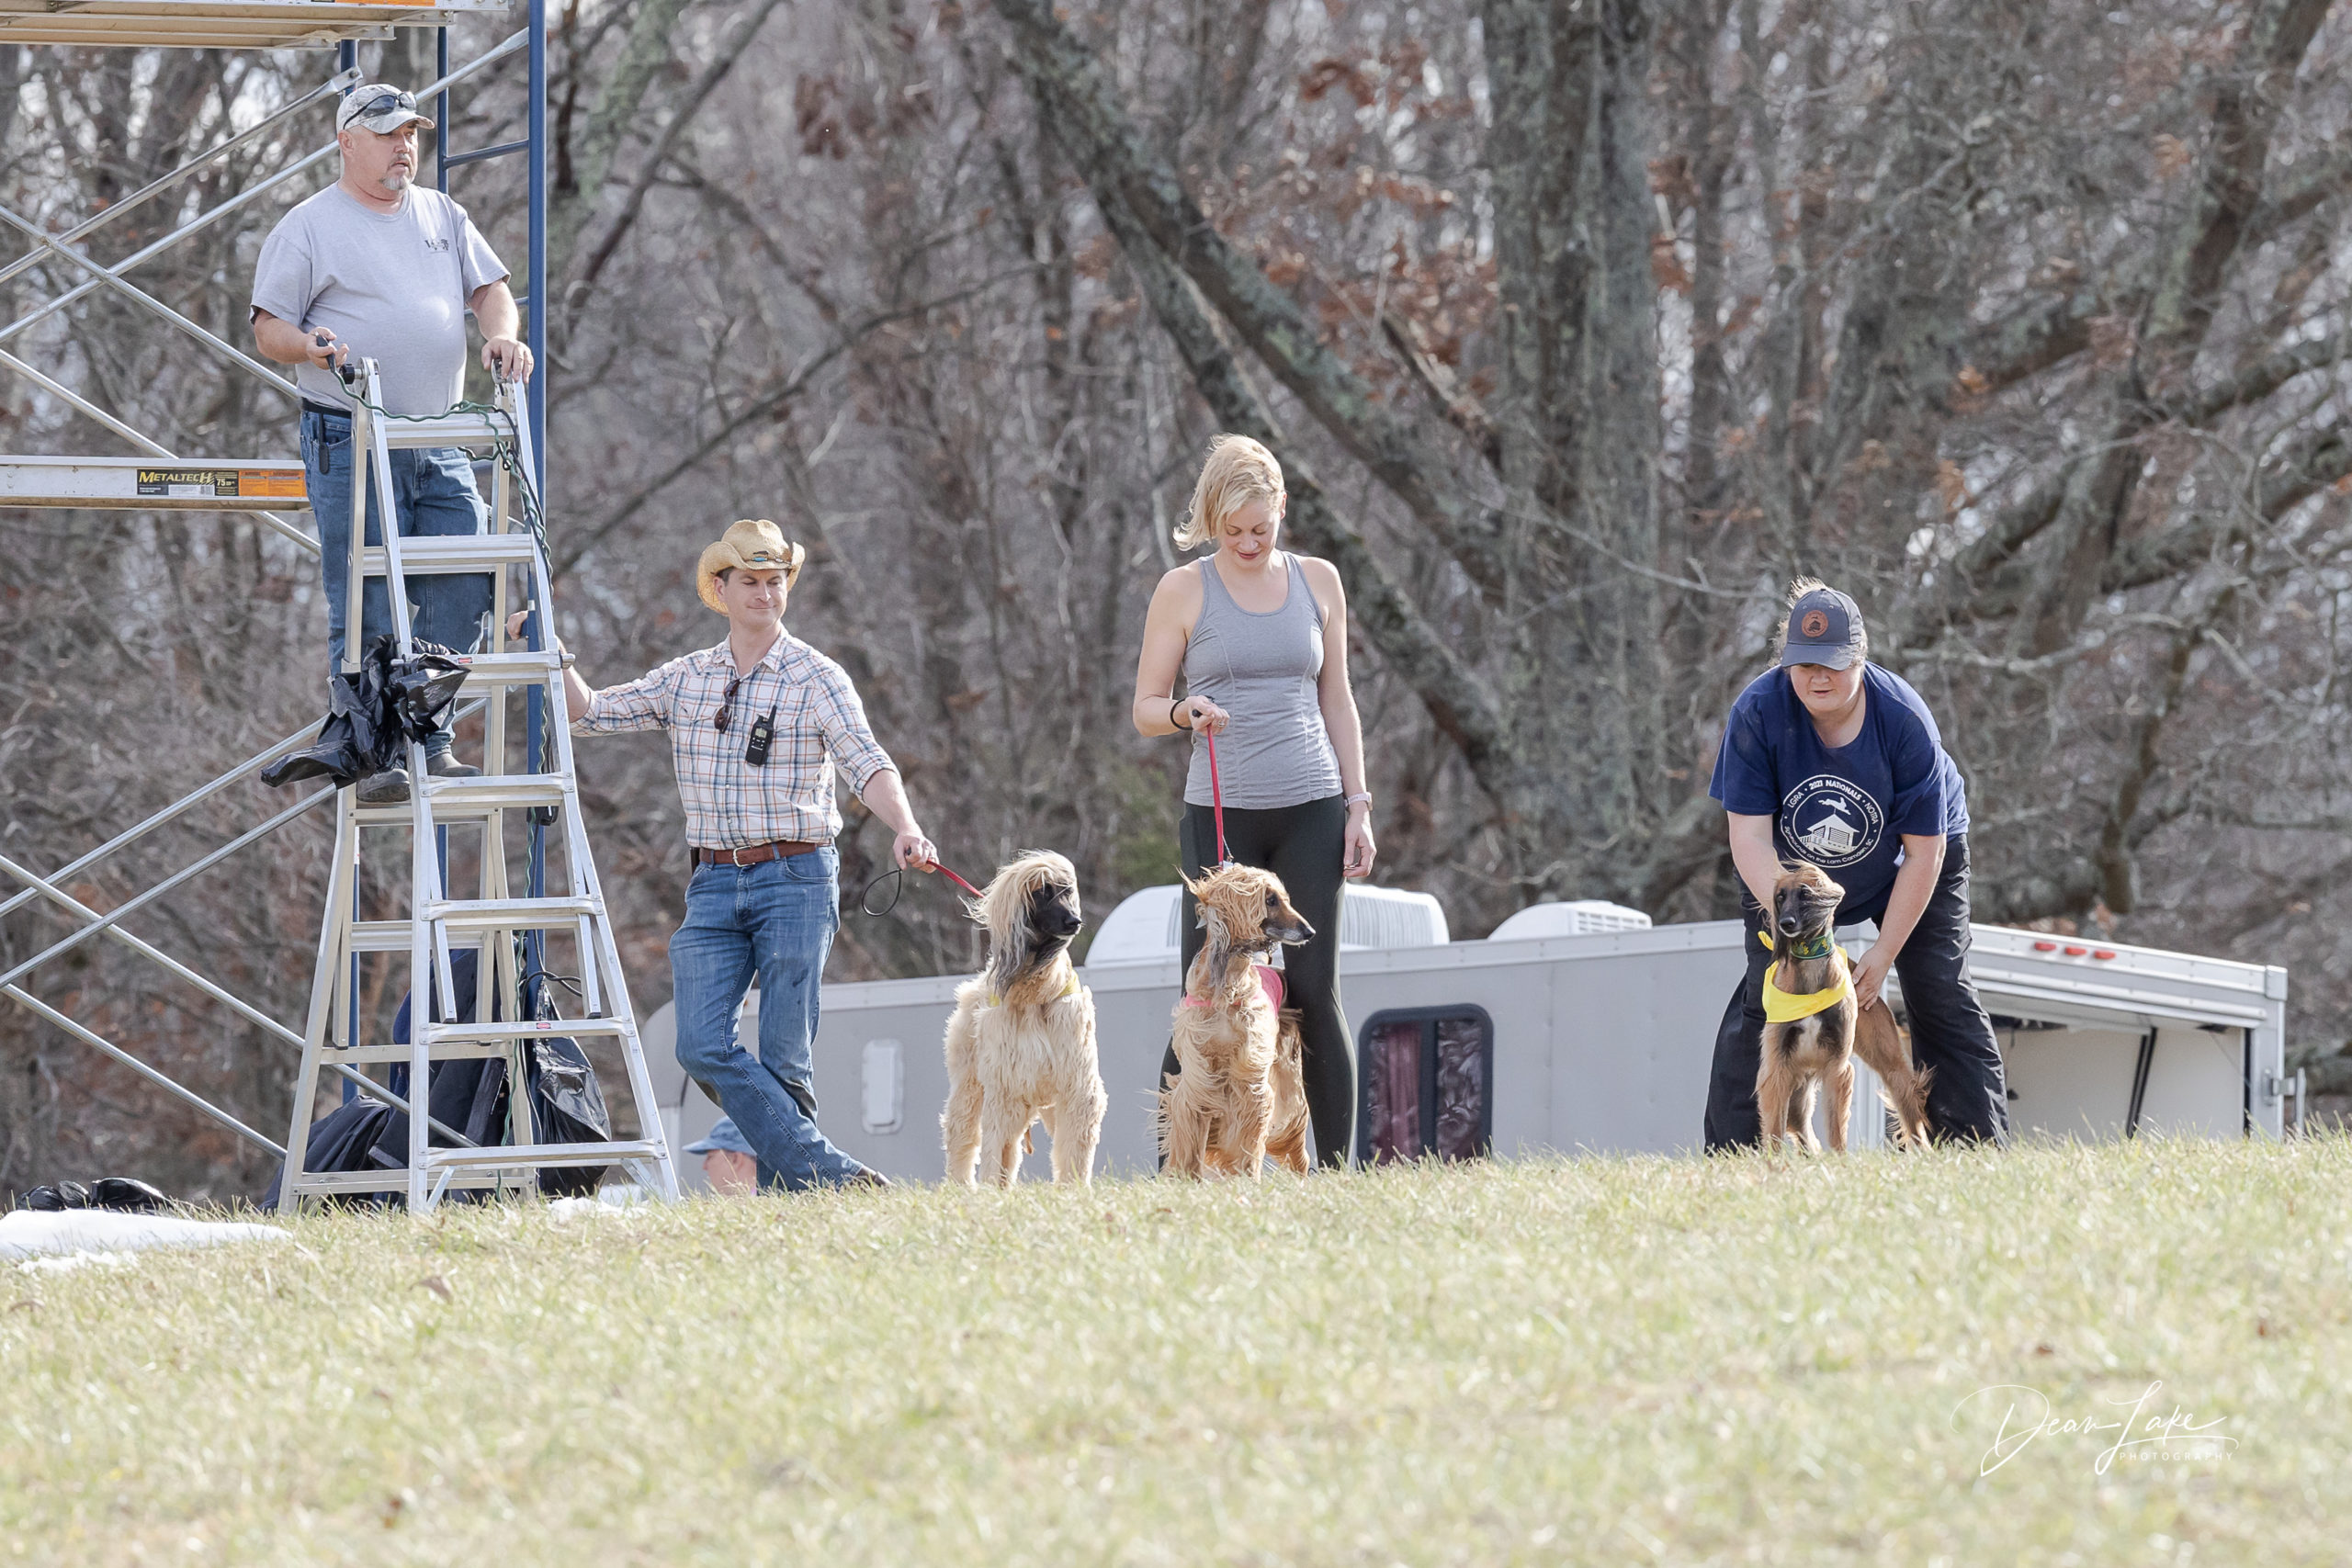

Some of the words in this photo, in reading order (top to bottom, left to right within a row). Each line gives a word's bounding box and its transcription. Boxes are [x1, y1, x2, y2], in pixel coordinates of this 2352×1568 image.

[139, 471, 212, 484] METALTECH
[217, 478, 226, 487] 75
[1787, 791, 1805, 808] LGRA
[1808, 779, 1824, 791] 2021
[1825, 779, 1862, 801] NATIONALS
[1864, 802, 1879, 825] NOTRA
[1806, 852, 1815, 861] on
[1815, 856, 1826, 864] the
[1865, 838, 1874, 847] SC
